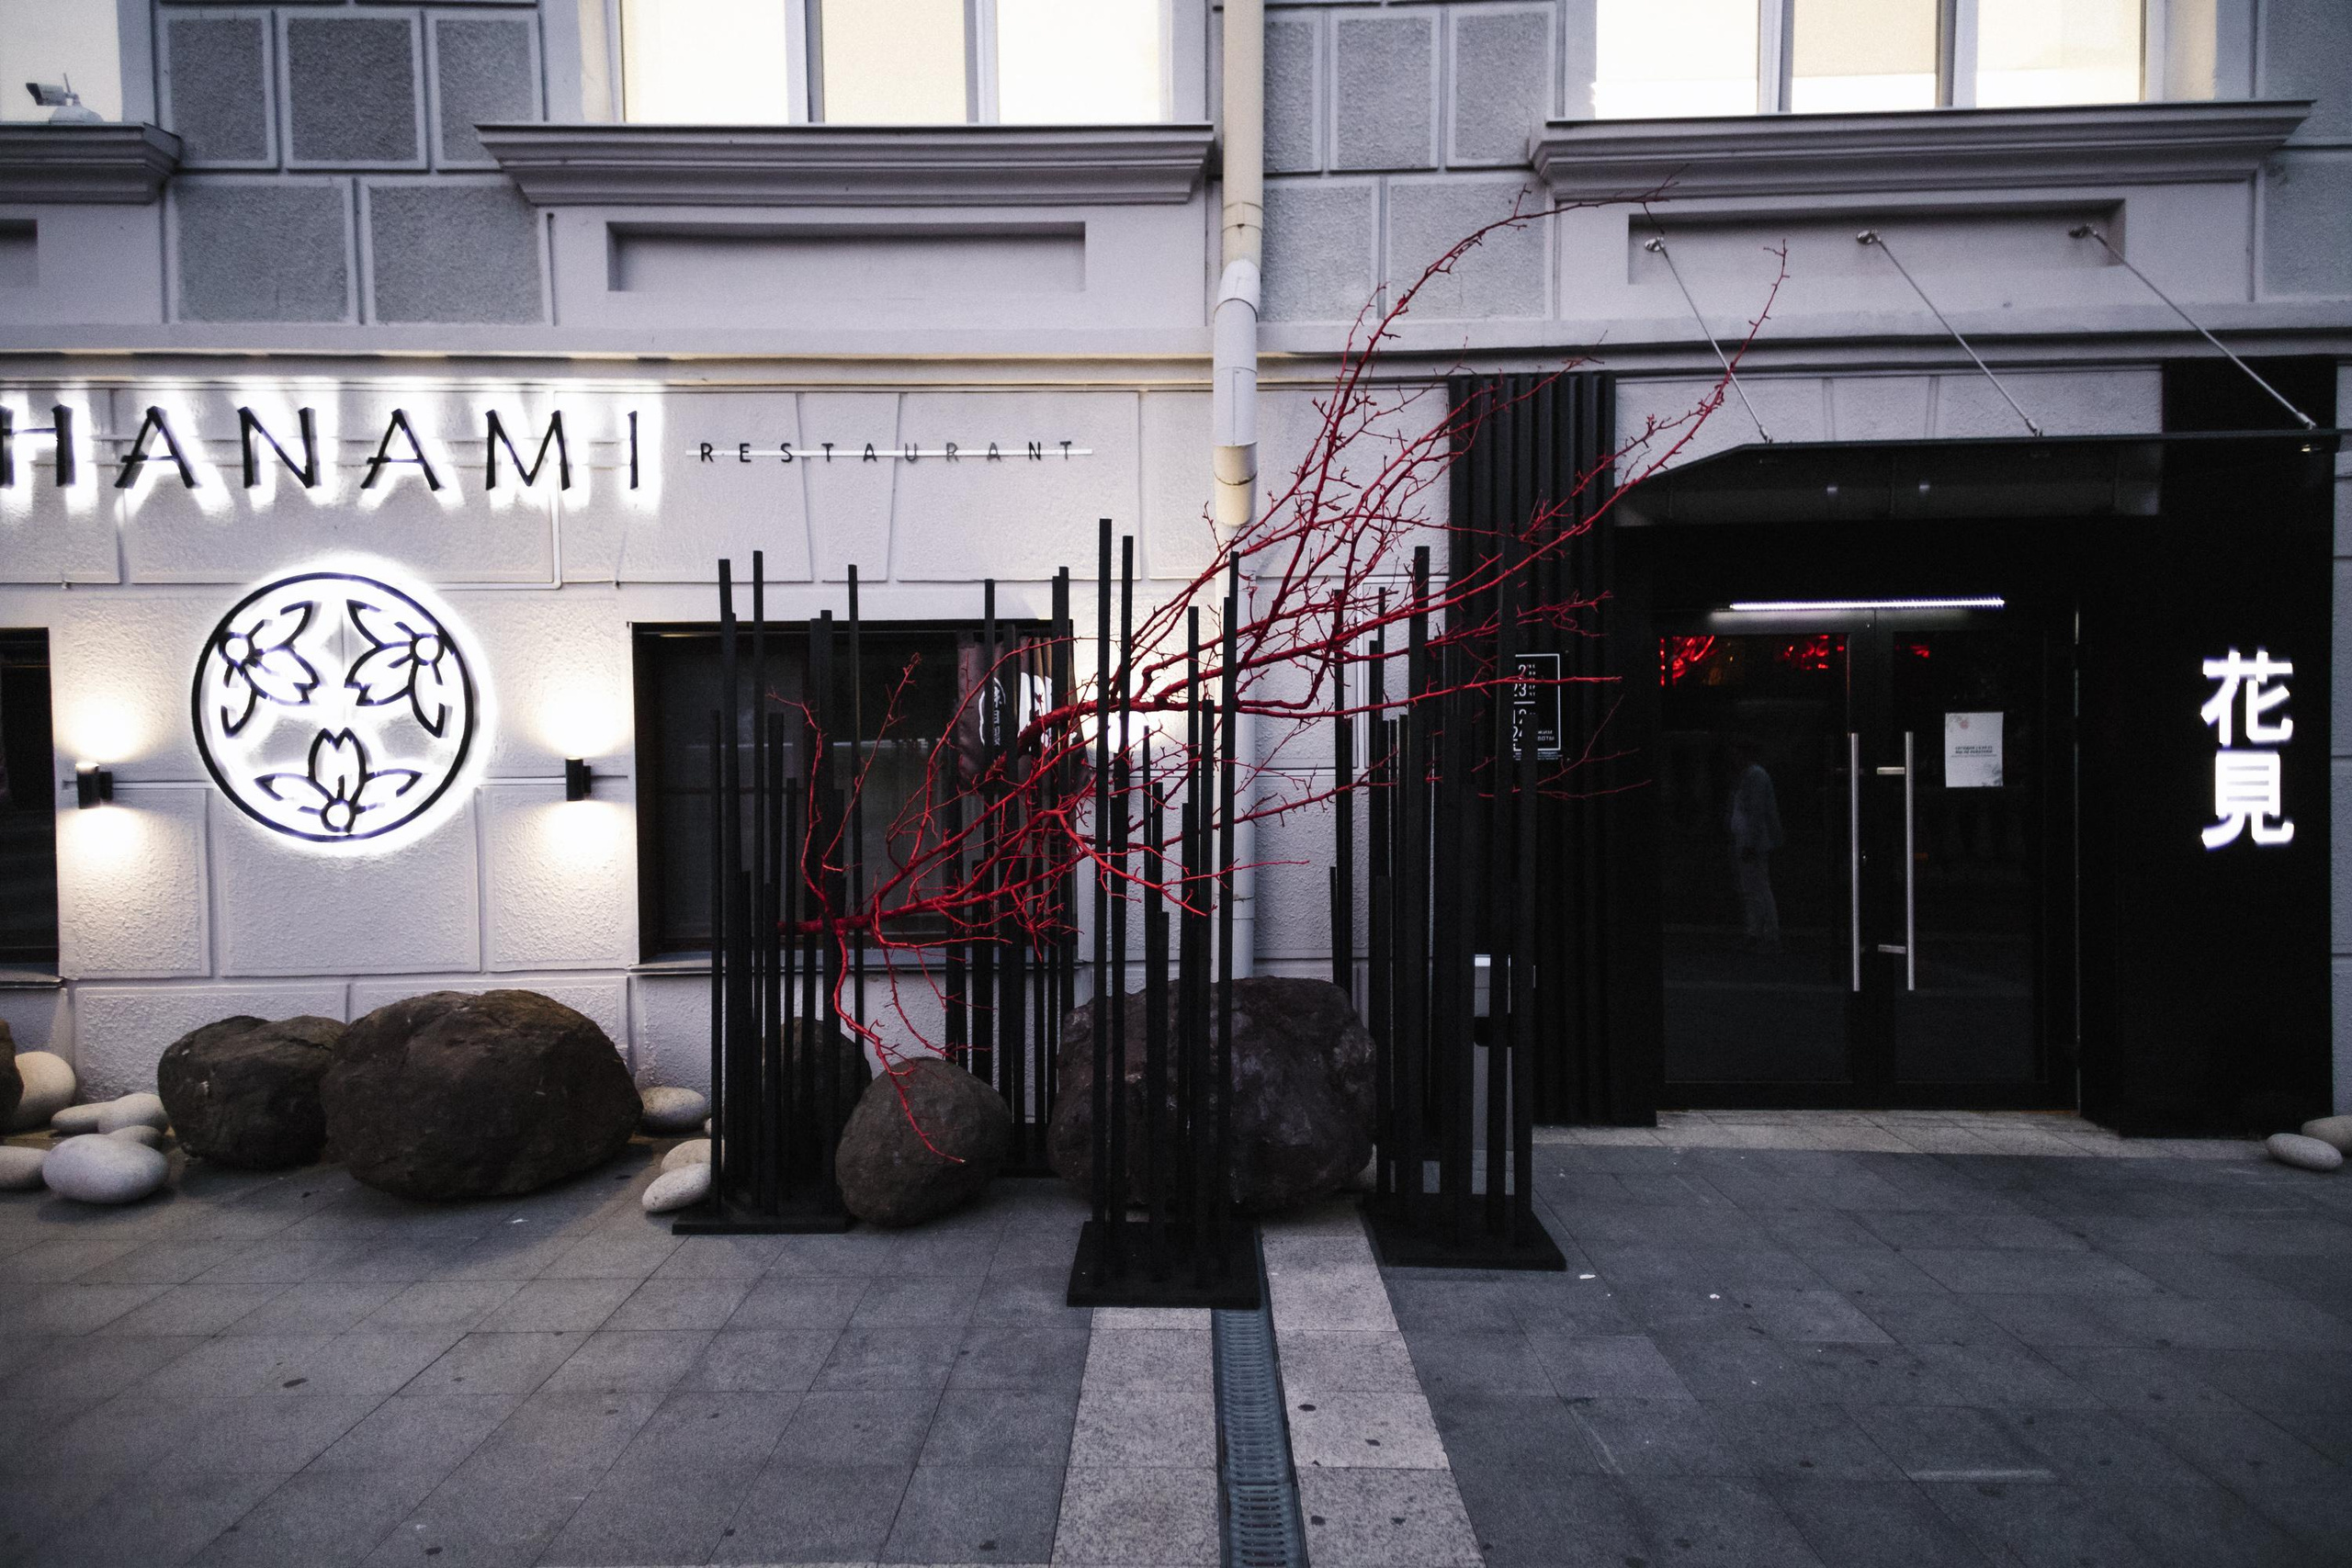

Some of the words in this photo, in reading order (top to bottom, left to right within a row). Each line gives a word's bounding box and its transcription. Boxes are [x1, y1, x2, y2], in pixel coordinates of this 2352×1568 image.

[0, 405, 639, 491] HANAMI
[699, 441, 1073, 463] RESTAURANT
[2200, 647, 2294, 850] 花見
